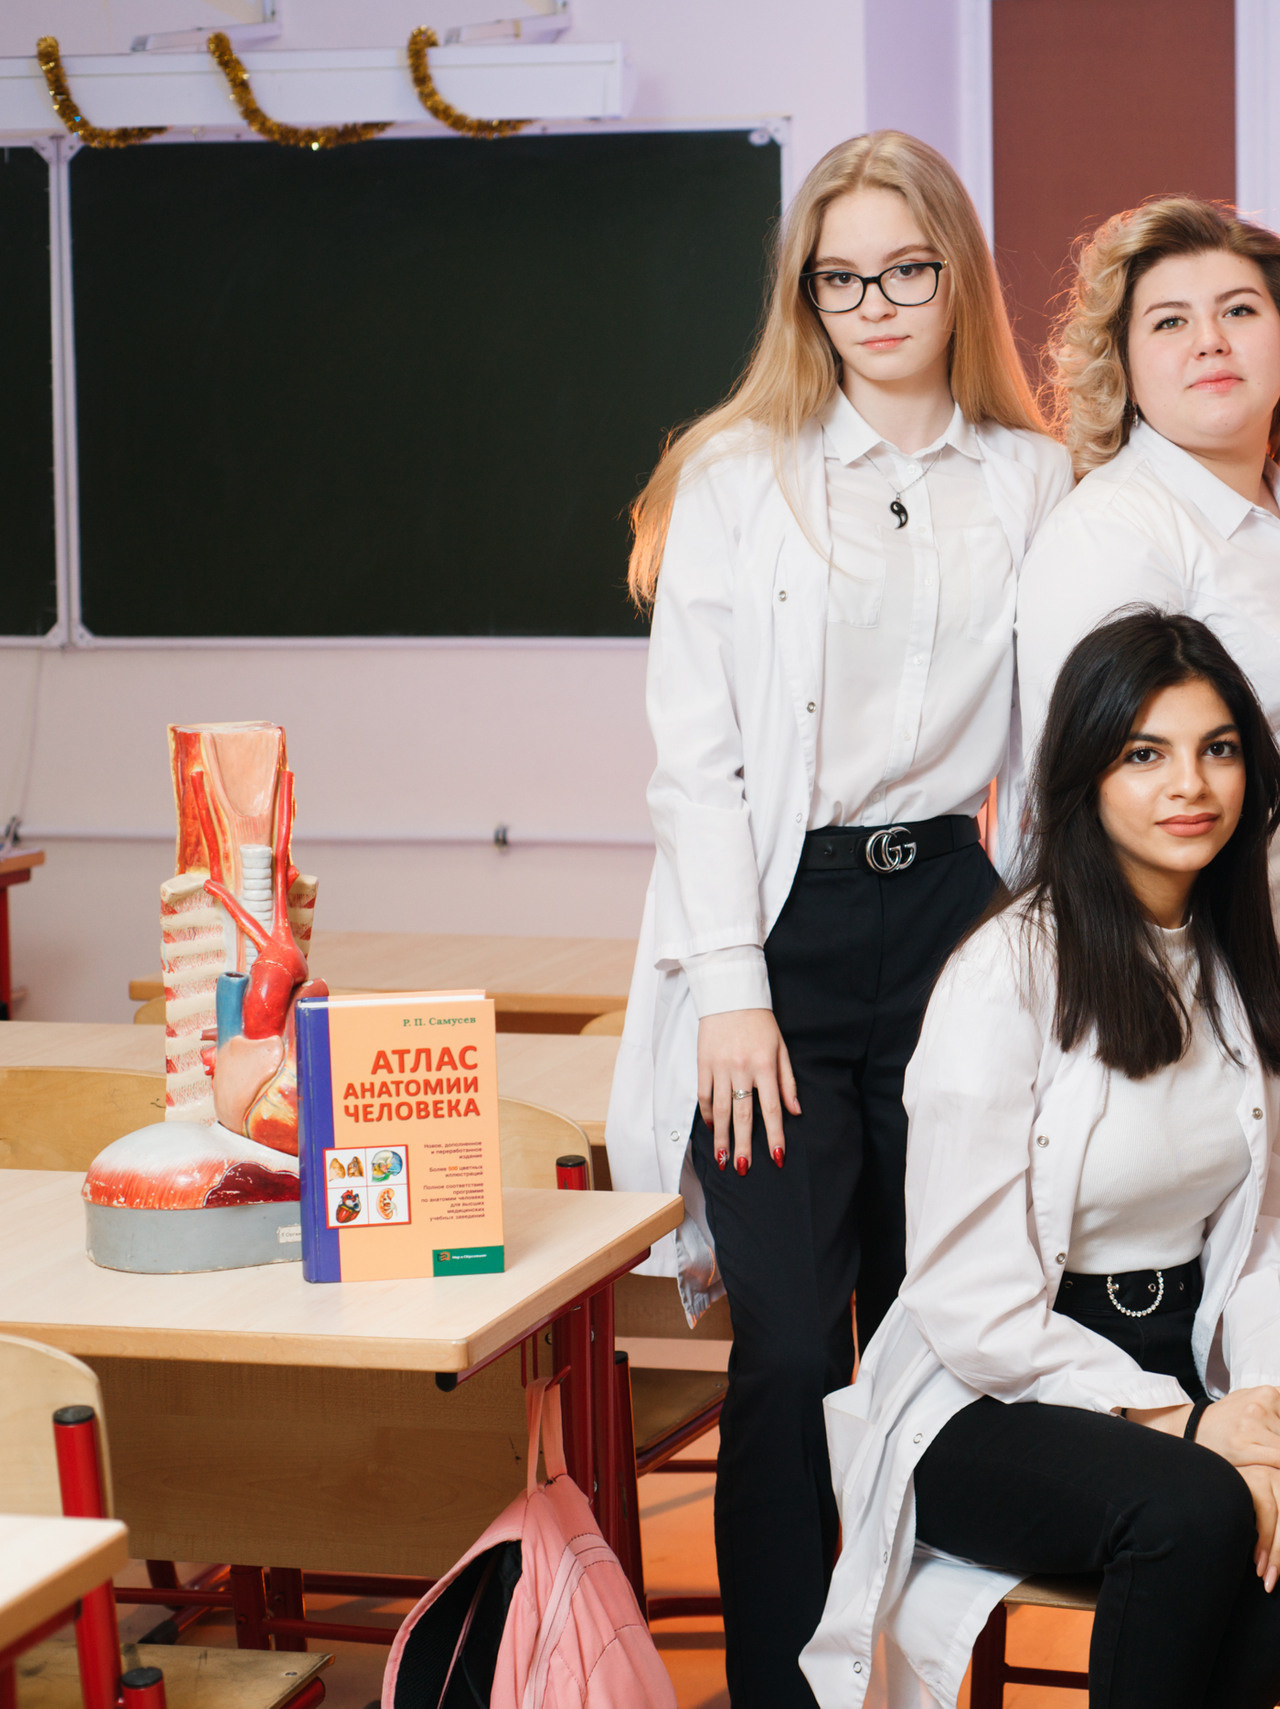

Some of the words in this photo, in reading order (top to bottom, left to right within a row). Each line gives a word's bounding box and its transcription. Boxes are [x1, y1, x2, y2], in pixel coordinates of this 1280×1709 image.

[403, 1018, 411, 1027] Р.
[414, 1018, 426, 1026] П.
[428, 1017, 477, 1027] Самусев
[370, 1045, 478, 1075] АТЛАС
[343, 1076, 479, 1100] АНАТОМИИ
[344, 1098, 481, 1123] ЧЕЛОВЕКА
